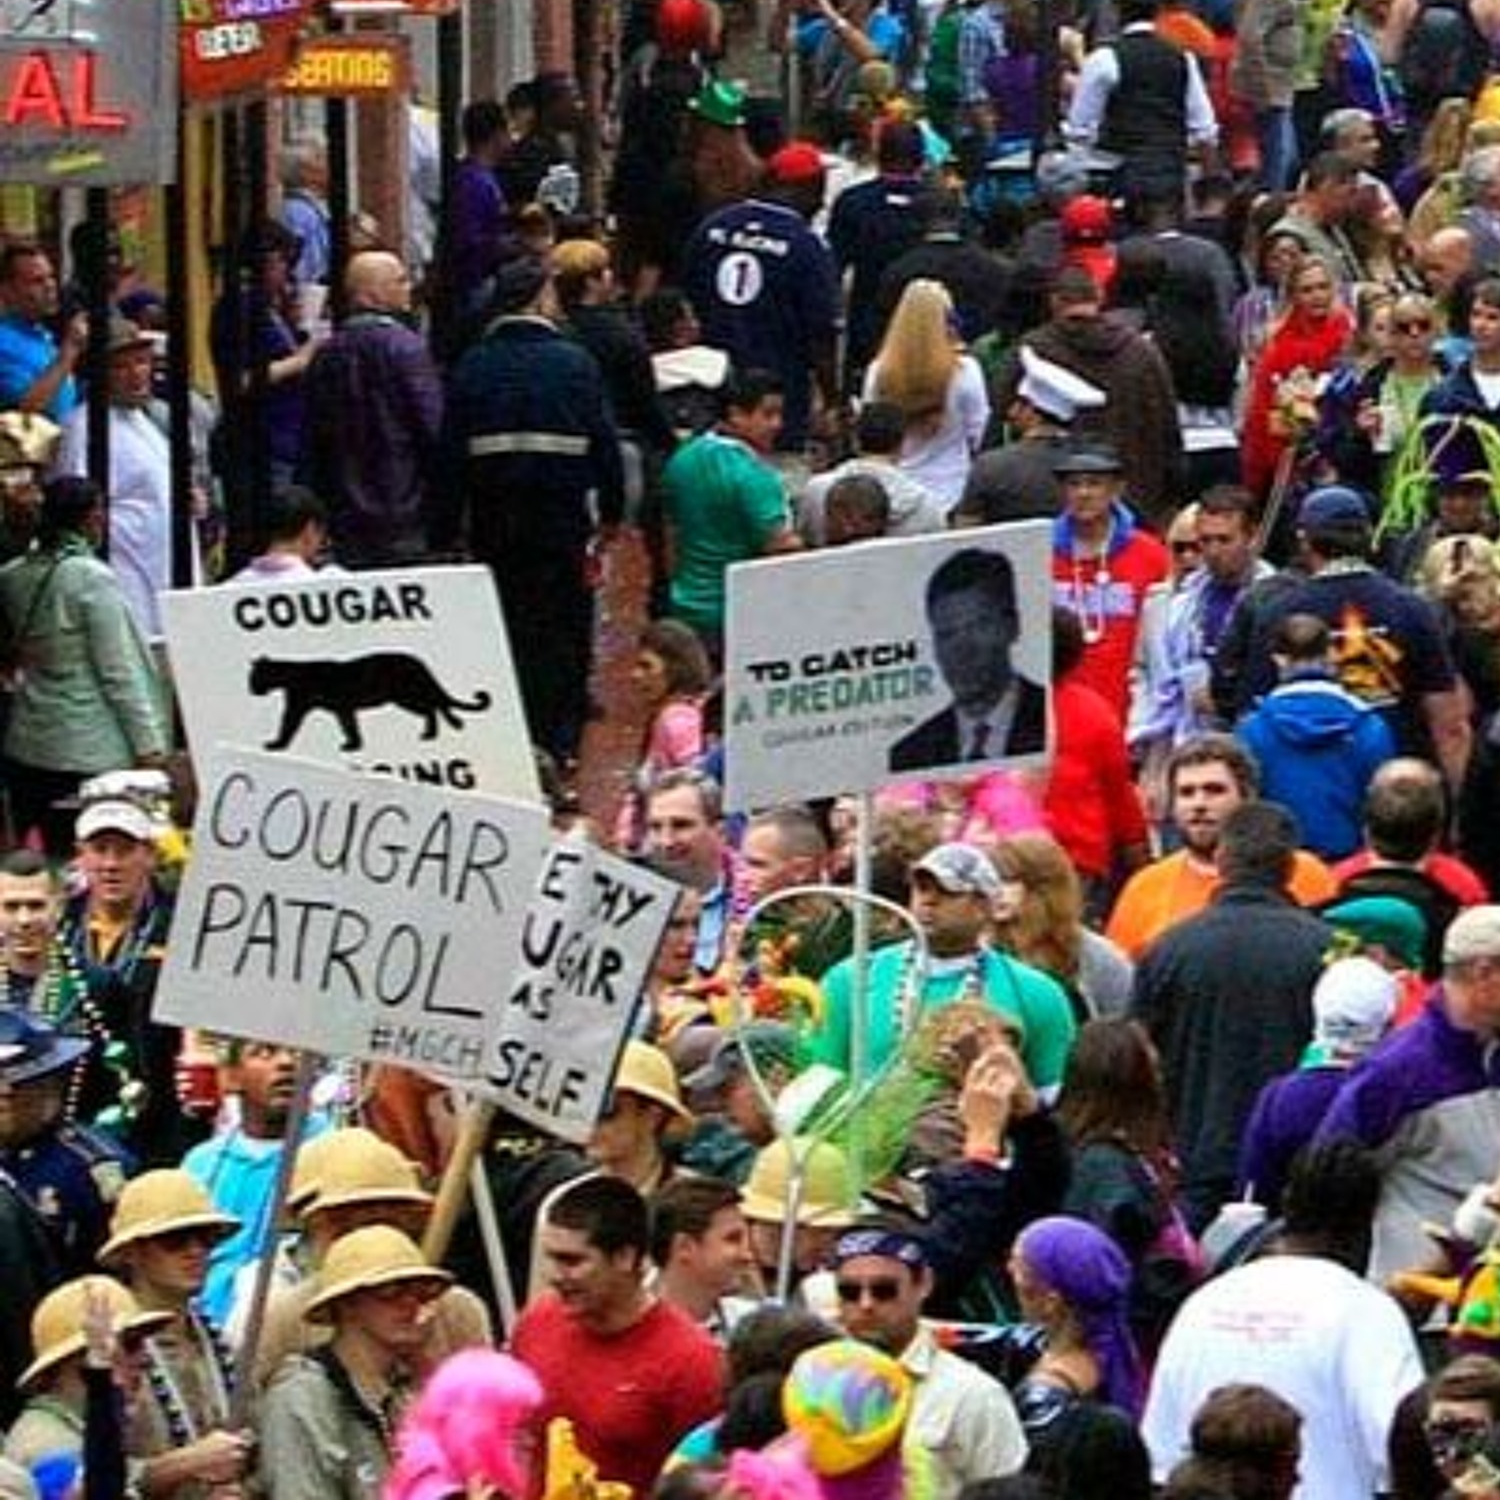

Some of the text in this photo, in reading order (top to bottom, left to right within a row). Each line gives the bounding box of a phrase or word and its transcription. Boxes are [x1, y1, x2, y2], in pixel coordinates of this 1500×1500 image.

[235, 584, 433, 631] COUGAR
[733, 664, 935, 726] A PREDATOR
[748, 641, 917, 681] TO CATCH
[210, 772, 509, 912] COUGAR
[190, 882, 485, 1019] PATROL
[522, 913, 624, 1002] UGAR
[488, 1040, 586, 1114] SELF
